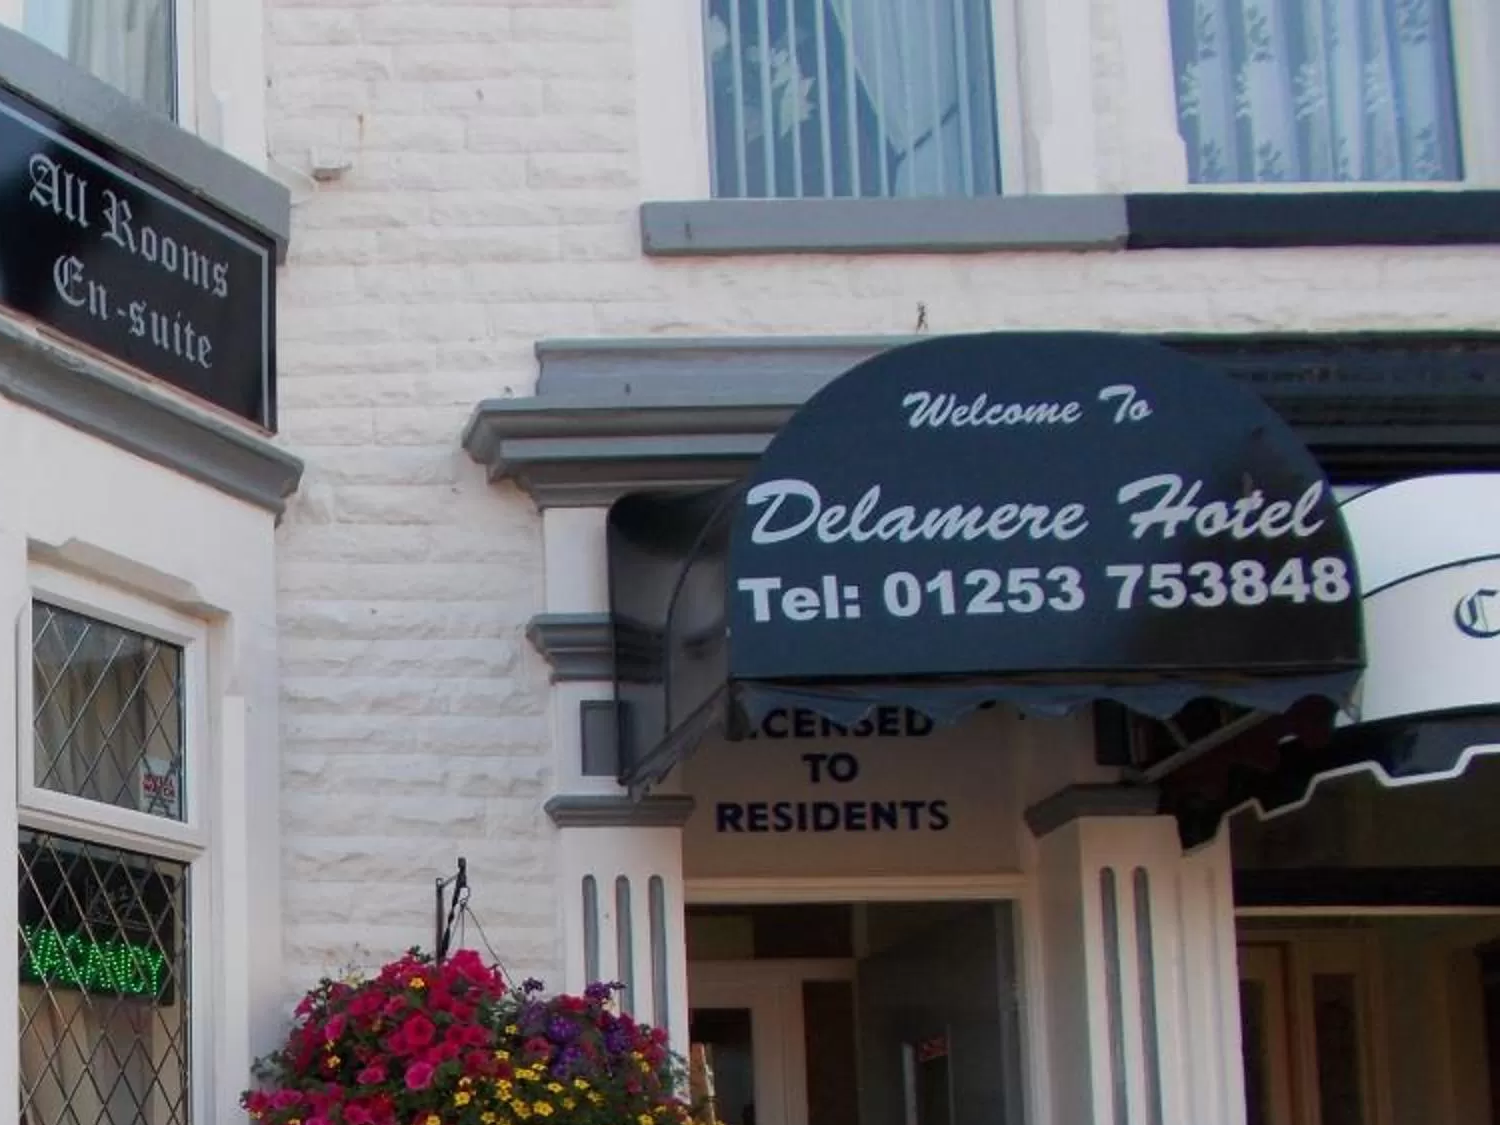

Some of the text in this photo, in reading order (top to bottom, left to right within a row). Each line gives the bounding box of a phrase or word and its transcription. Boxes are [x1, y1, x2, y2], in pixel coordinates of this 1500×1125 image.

[29, 153, 229, 298] All Rooms
[53, 255, 212, 369] En-suite
[902, 384, 1153, 429] Welcome To
[746, 473, 1325, 545] Delamere Hotel
[737, 556, 1351, 622] Tel: 01253 753848
[802, 752, 860, 784] TO
[715, 799, 950, 833] RESIDENTS
